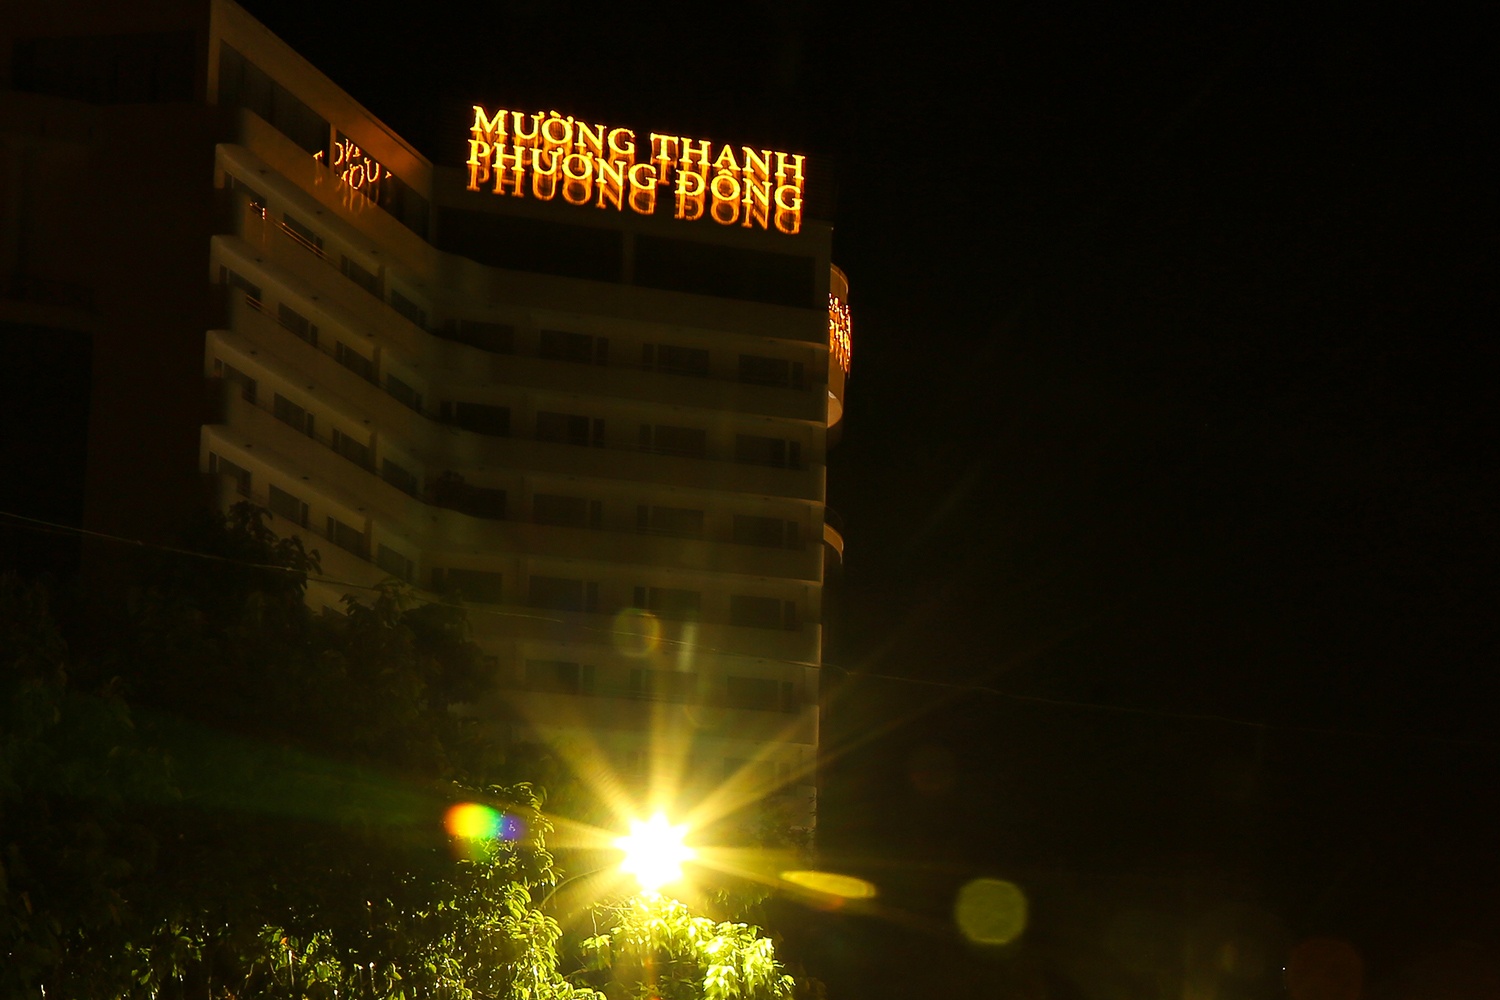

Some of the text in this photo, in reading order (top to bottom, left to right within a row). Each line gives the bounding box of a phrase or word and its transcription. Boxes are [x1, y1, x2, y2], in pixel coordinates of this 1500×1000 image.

[466, 138, 803, 213] PHƯƠNG ĐÔNG
[469, 105, 806, 181] MƯỜNG THANH
